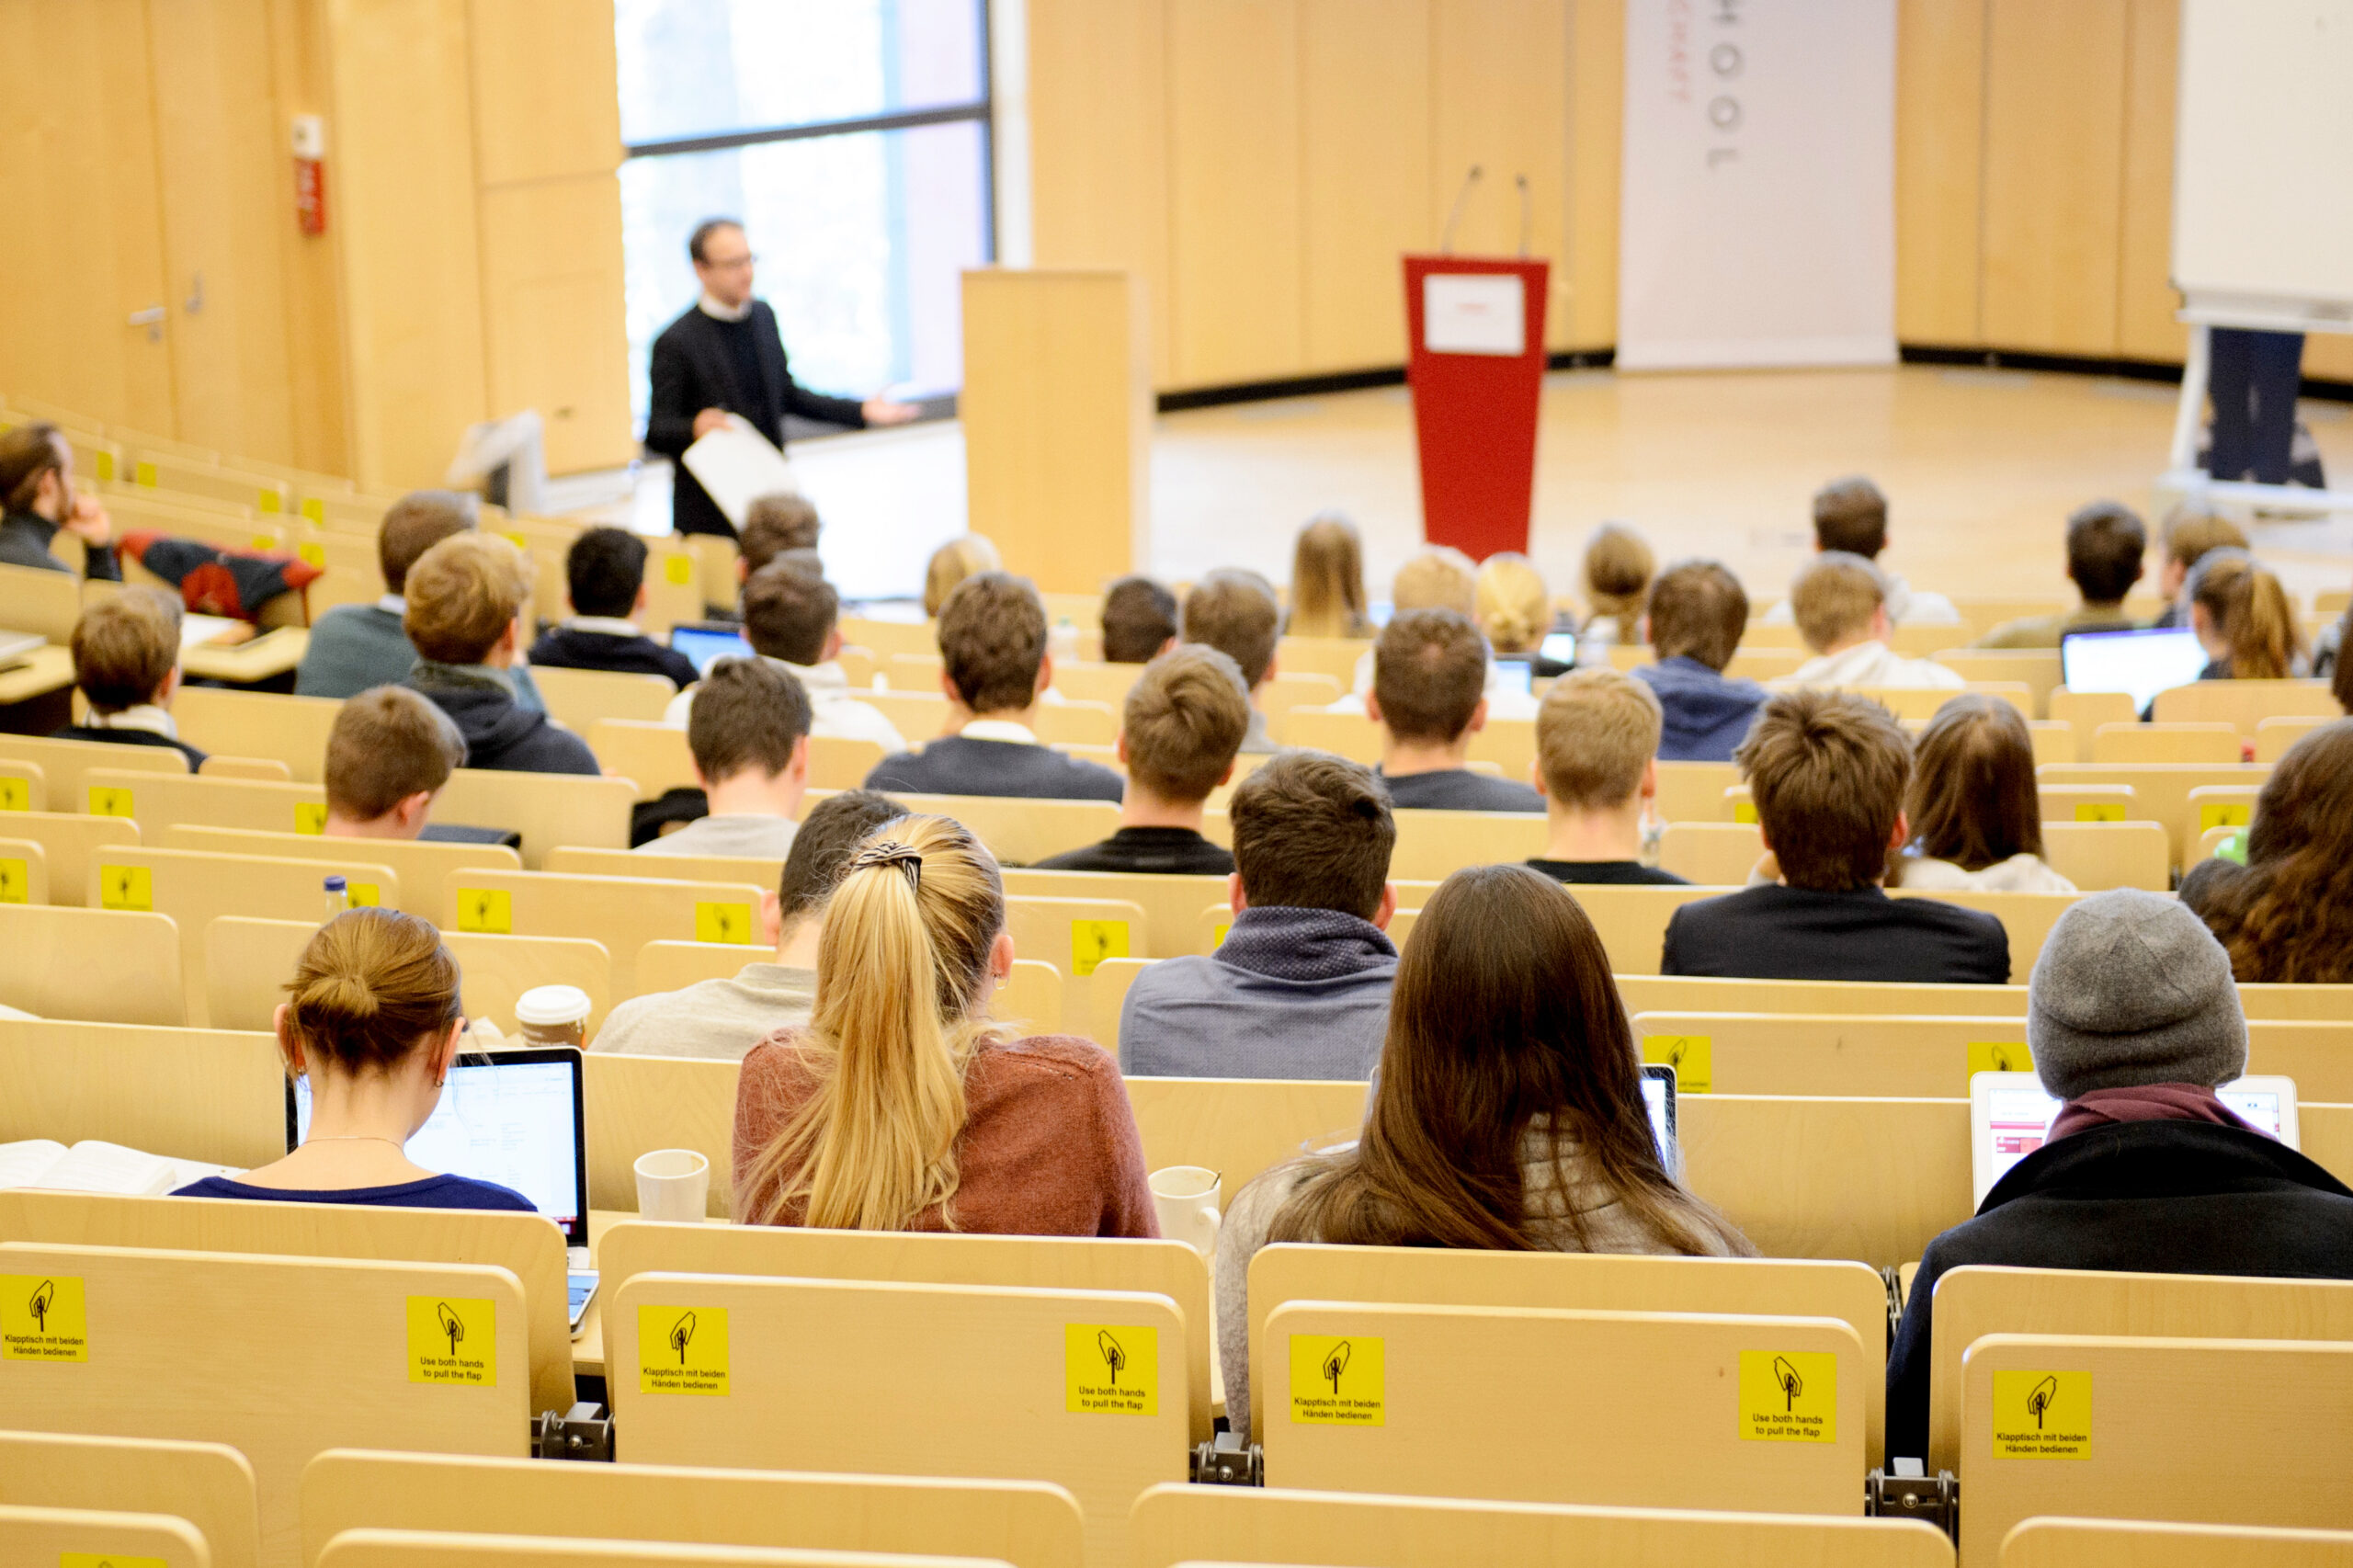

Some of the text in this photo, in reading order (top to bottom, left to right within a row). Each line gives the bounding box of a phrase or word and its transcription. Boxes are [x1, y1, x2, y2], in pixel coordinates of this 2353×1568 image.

[5, 1335, 85, 1346] Klapptisch mit beiden
[13, 1346, 77, 1357] Händen bedienen
[420, 1357, 484, 1369] Use both hands
[434, 1369, 449, 1380] pull
[451, 1370, 464, 1379] the
[466, 1371, 483, 1382] flap
[642, 1368, 684, 1378] Klapptisch
[699, 1370, 726, 1379] beiden
[651, 1380, 719, 1390] Händen bedienen
[1078, 1386, 1146, 1397] Use both hands
[1081, 1399, 1143, 1411] to pull the flap
[1294, 1397, 1381, 1408] Klapptisch mit beiden
[1302, 1410, 1372, 1419] Händen bedienen
[1752, 1414, 1823, 1425] Use both hands
[1767, 1426, 1784, 1437] pull
[1786, 1427, 1801, 1436] the
[1802, 1427, 1820, 1437] flap
[1995, 1433, 2041, 1443] Klapptisch
[2059, 1434, 2087, 1442] beiden
[2005, 1445, 2079, 1453] Händen bedienen
